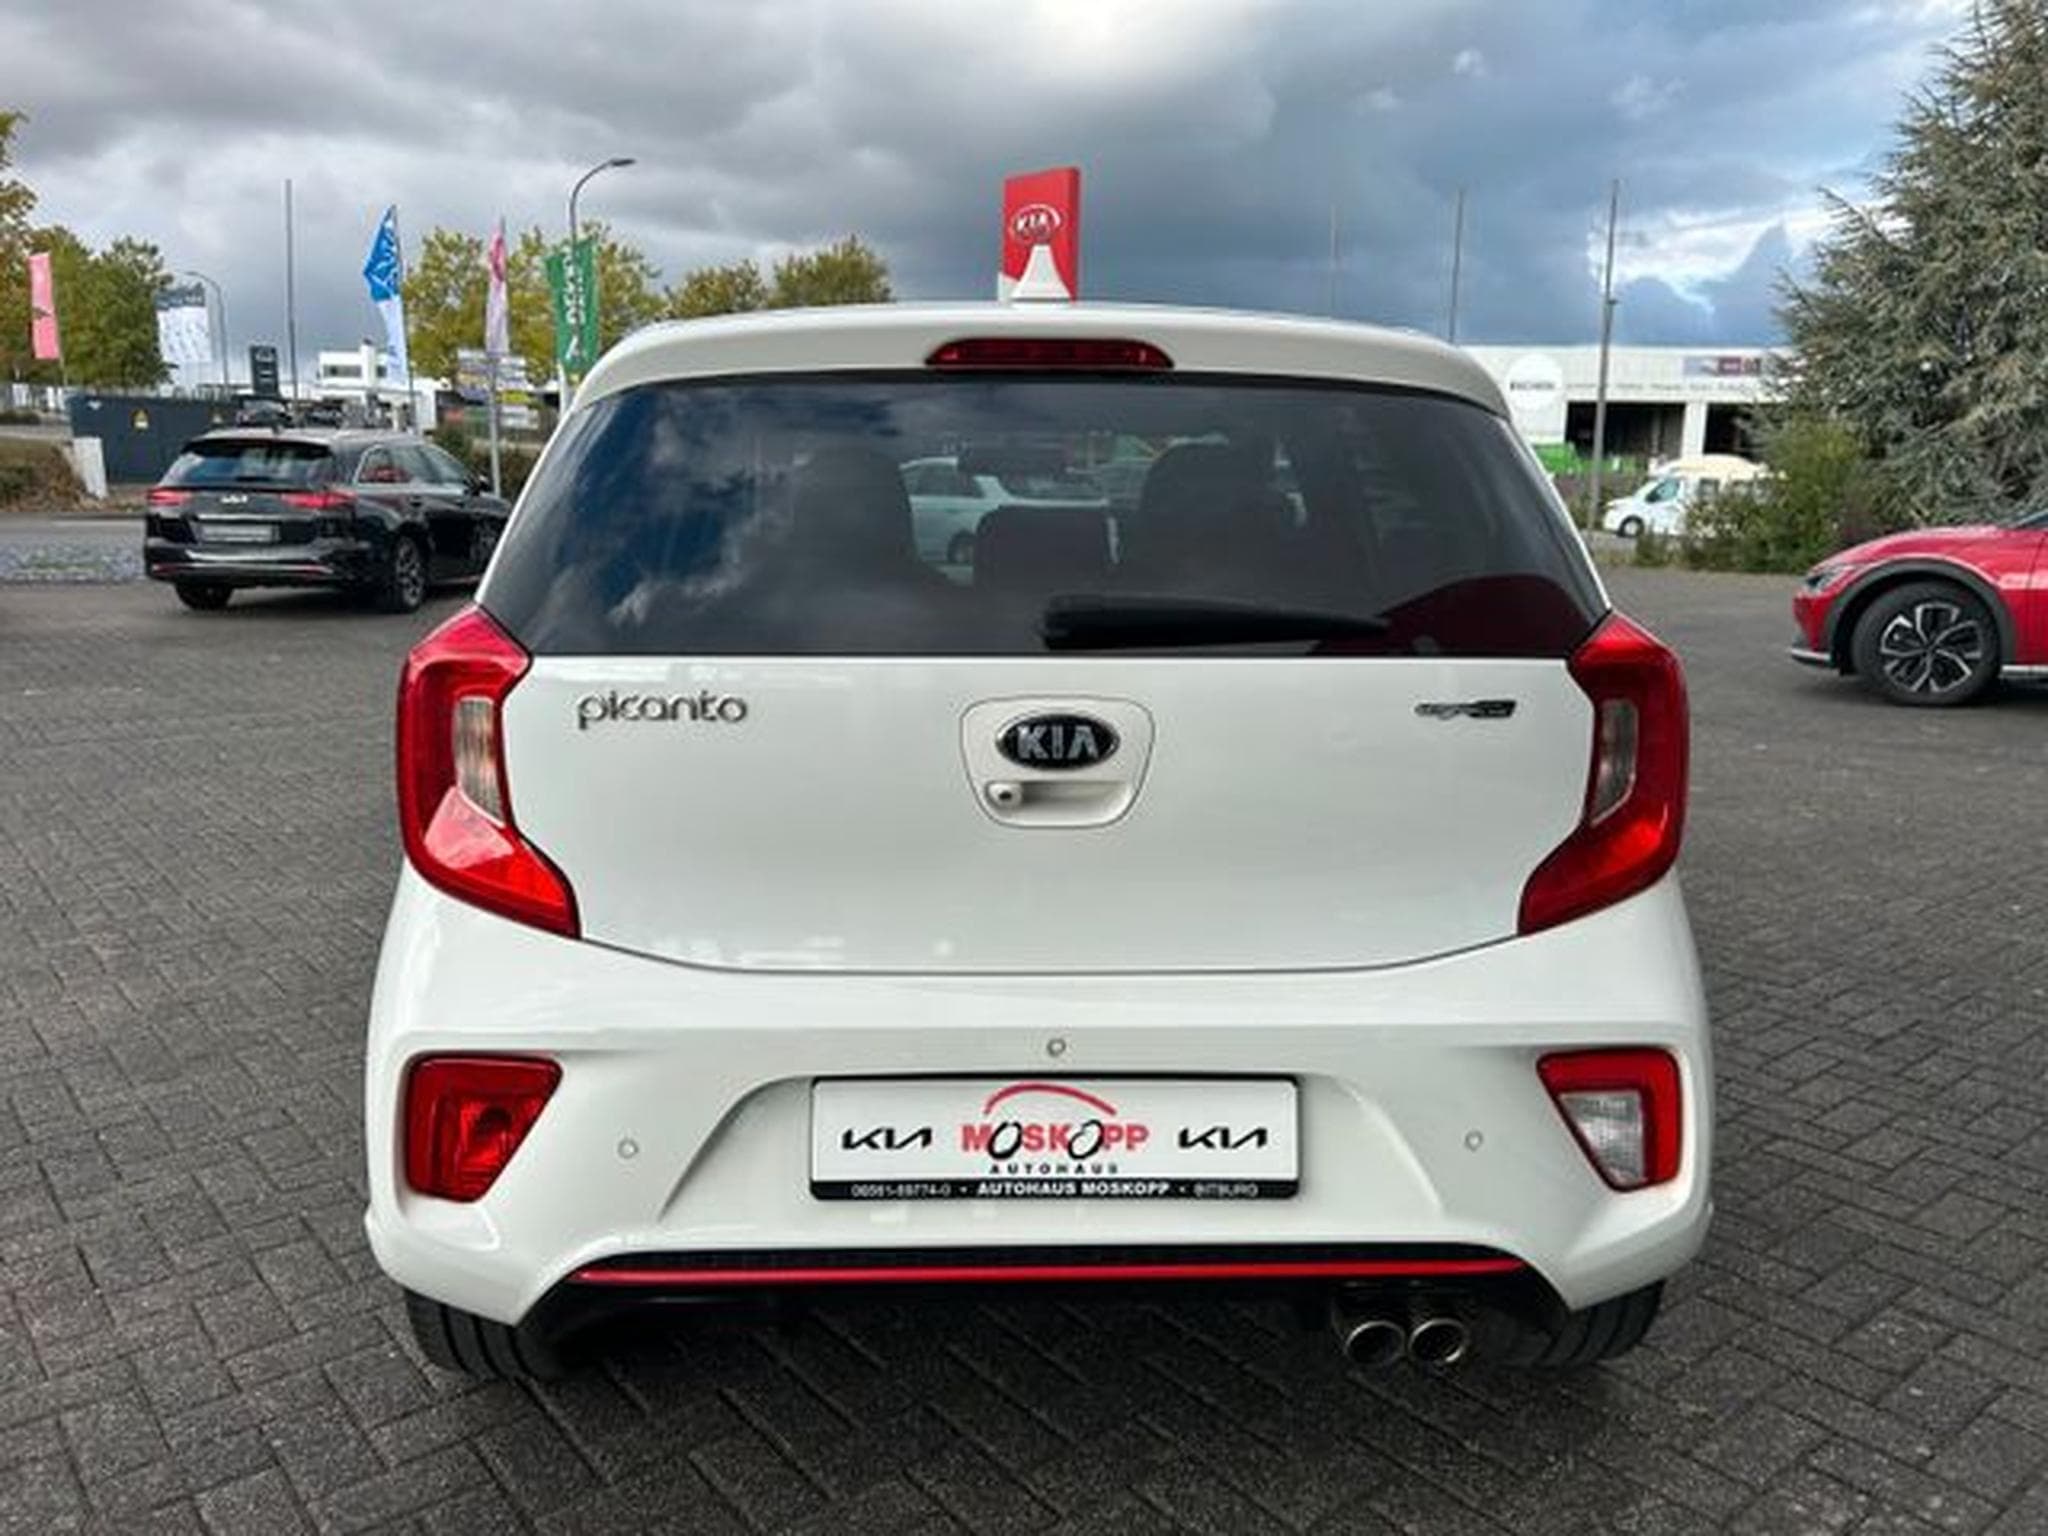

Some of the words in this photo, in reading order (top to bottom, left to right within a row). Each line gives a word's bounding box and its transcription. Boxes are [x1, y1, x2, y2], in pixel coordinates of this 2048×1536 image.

[578, 690, 748, 730] picanto
[1017, 724, 1100, 760] KIA
[842, 1126, 932, 1149] KIA
[961, 1120, 1149, 1160] MOSKOPP
[1178, 1126, 1268, 1149] KIA
[989, 1164, 1119, 1174] AUTOHAUS
[977, 1182, 1077, 1196] AUTOHAUS
[1081, 1182, 1171, 1195] MOSKOPP
